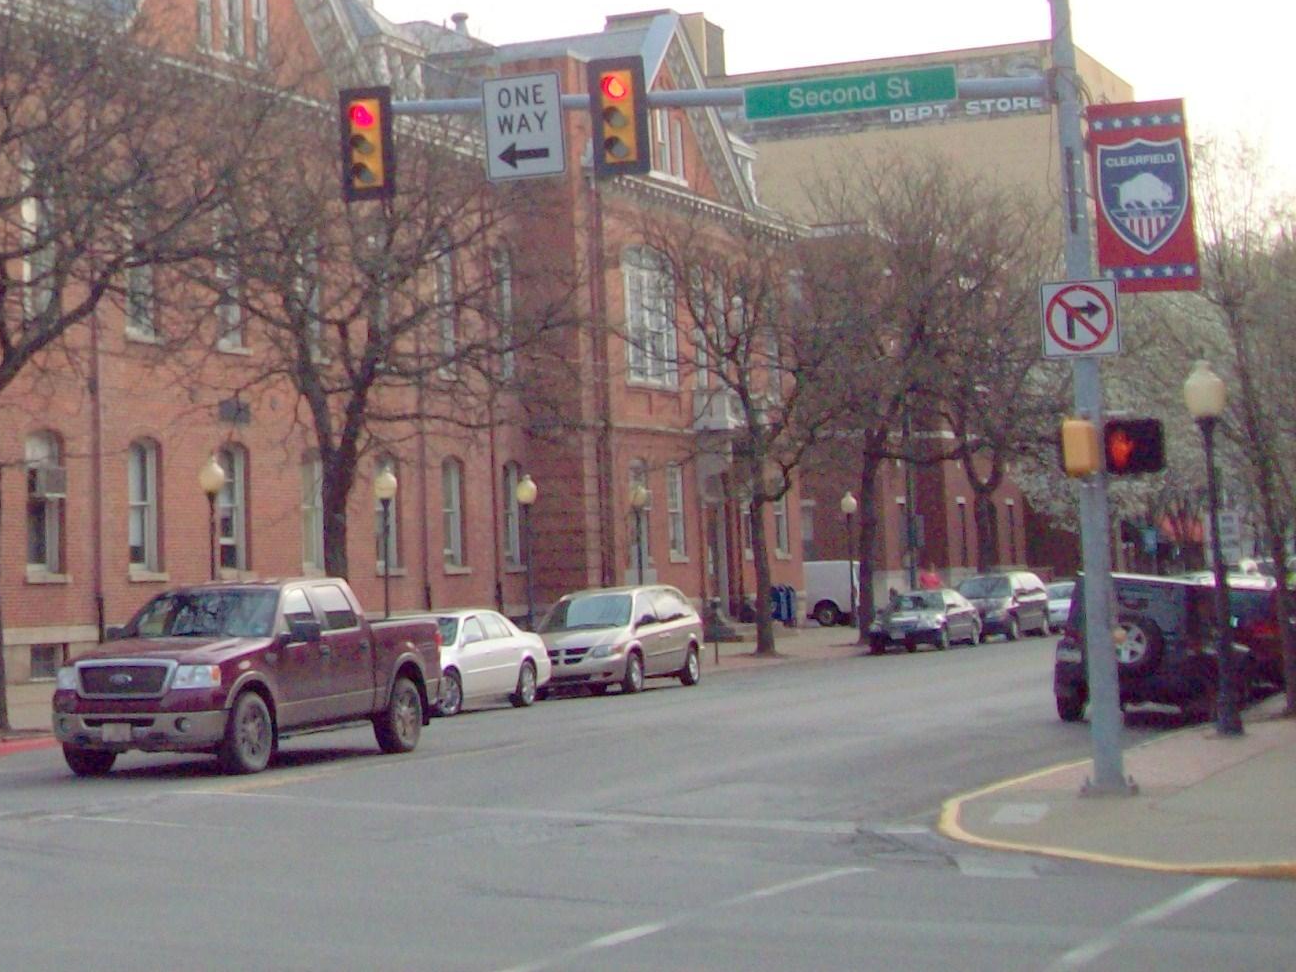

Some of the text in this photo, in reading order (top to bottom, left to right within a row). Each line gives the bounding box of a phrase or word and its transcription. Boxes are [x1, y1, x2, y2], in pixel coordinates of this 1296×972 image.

[497, 83, 545, 109] ONE
[787, 76, 912, 108] Second St
[965, 96, 1043, 116] STORE
[497, 111, 548, 135] WAY
[1106, 153, 1175, 167] CLEARFIELD
